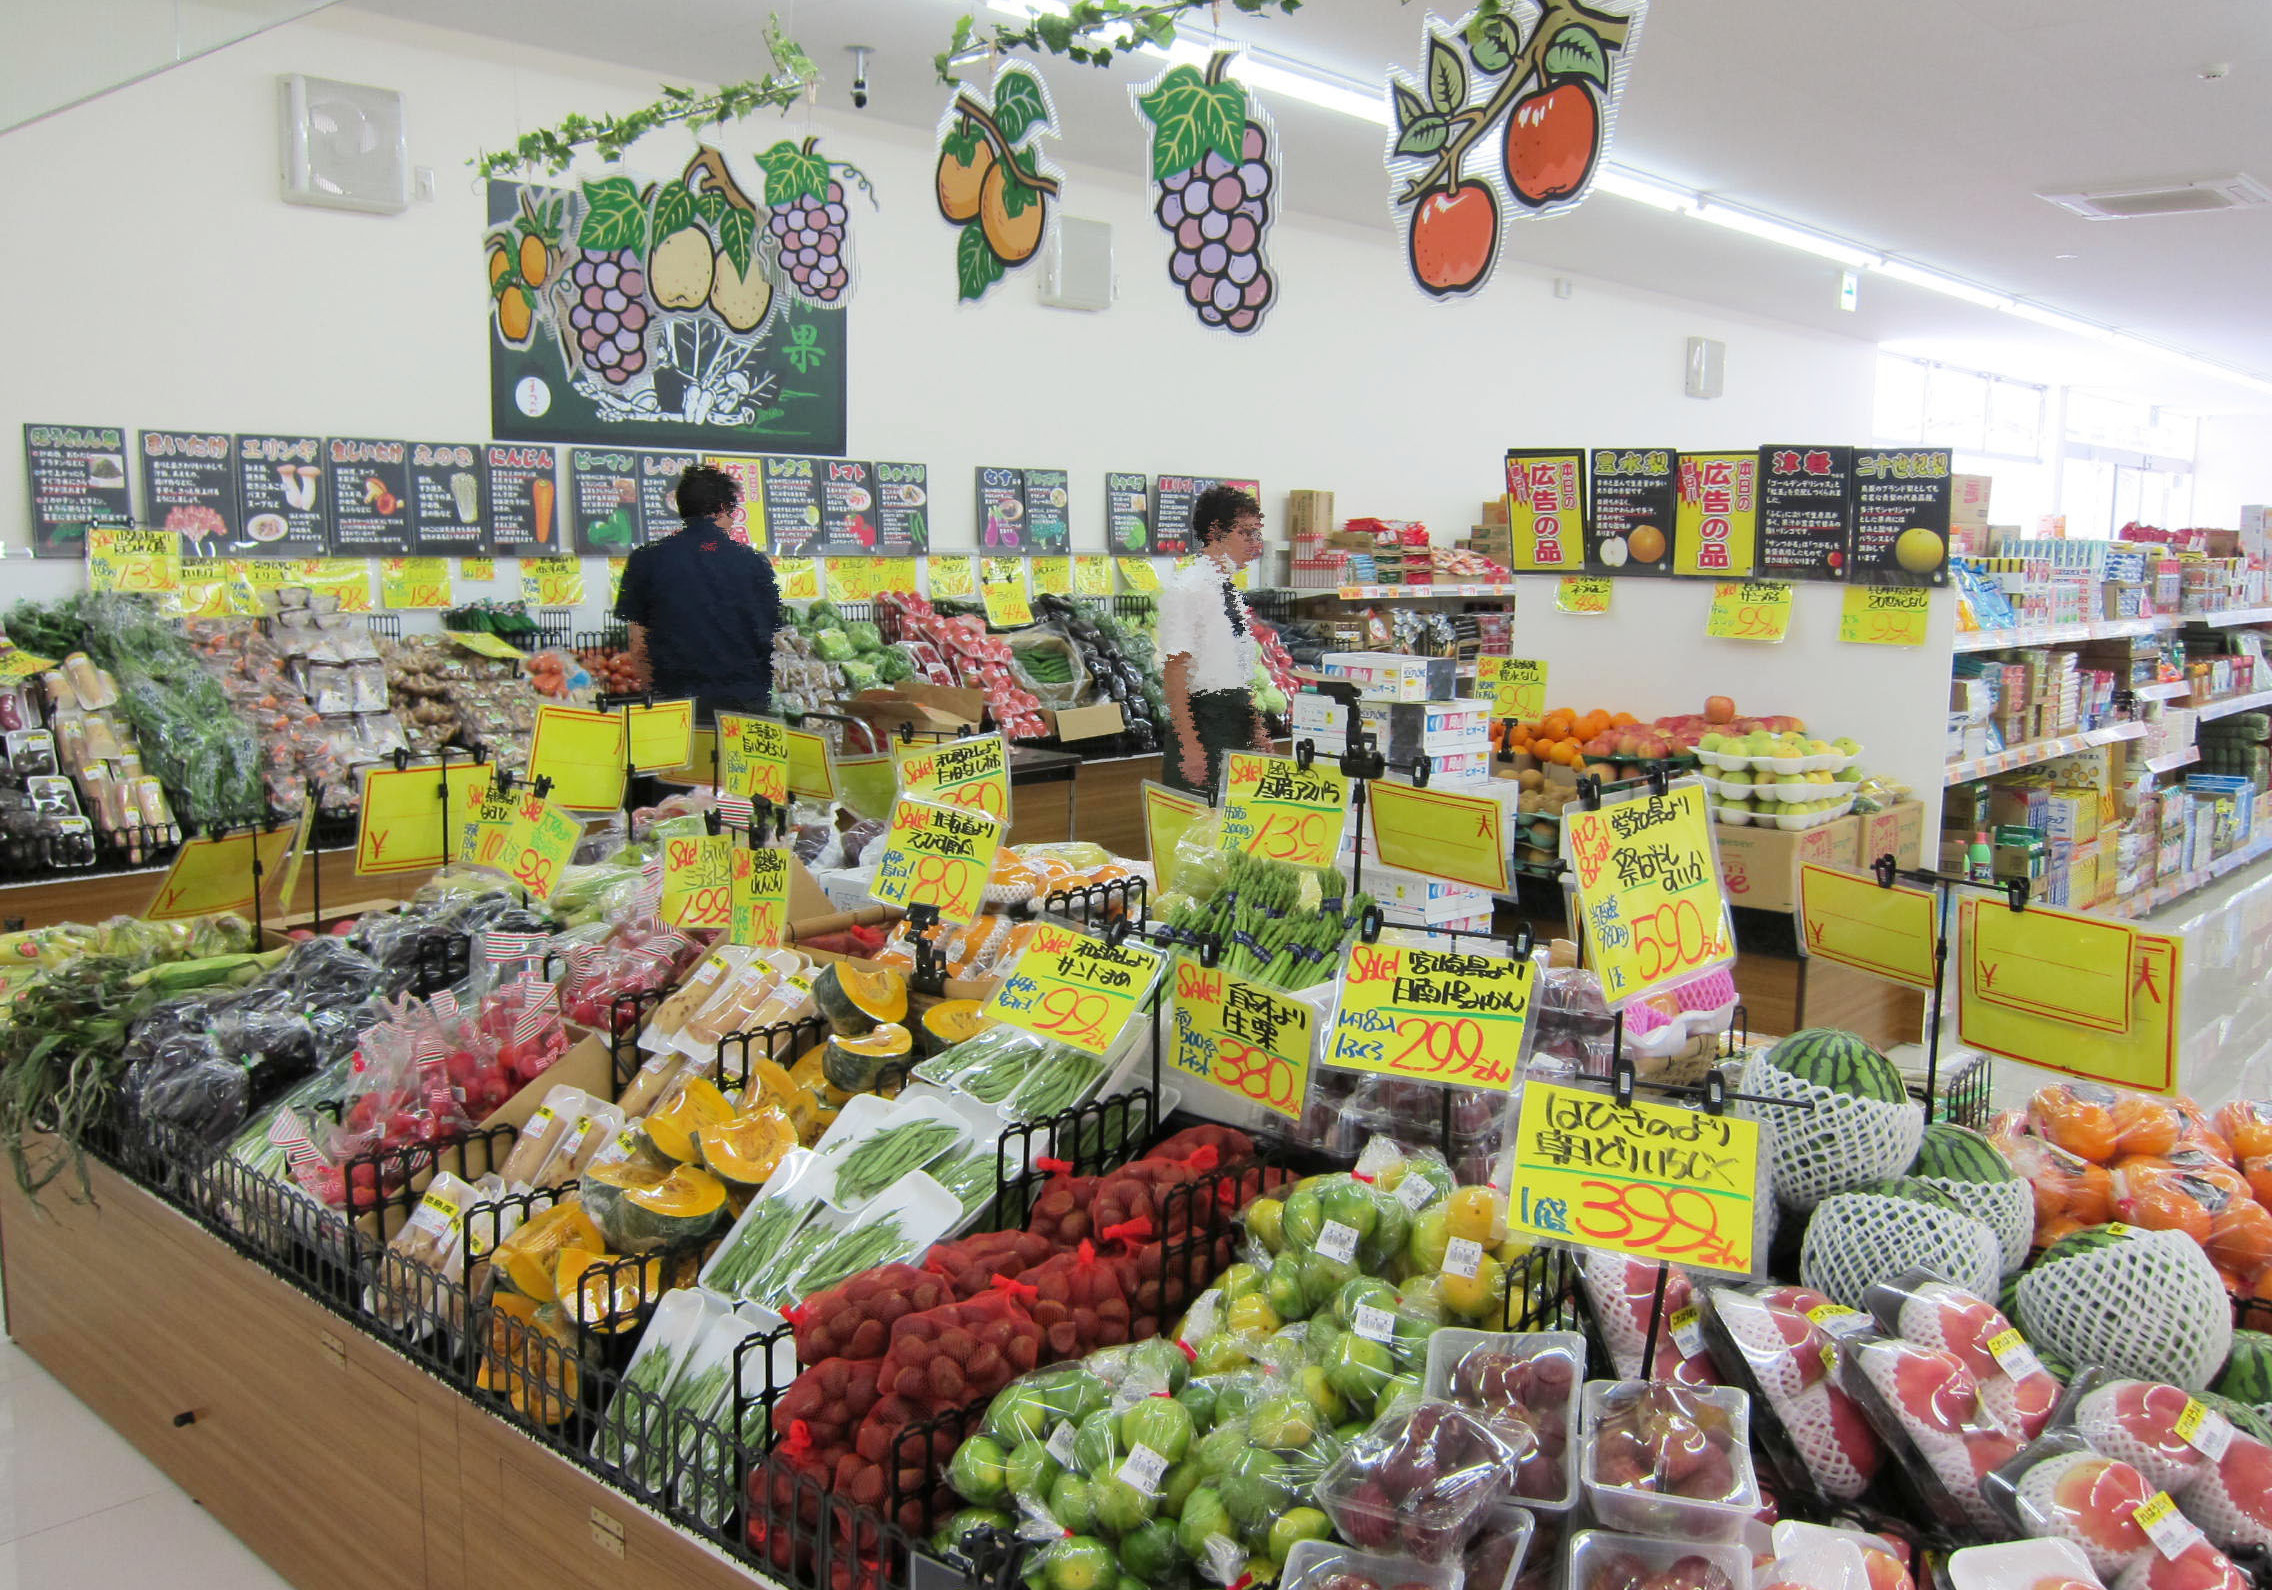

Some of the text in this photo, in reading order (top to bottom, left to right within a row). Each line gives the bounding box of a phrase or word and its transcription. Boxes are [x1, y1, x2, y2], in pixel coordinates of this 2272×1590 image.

[782, 324, 826, 374] 果
[241, 438, 318, 462] エリンギ
[413, 444, 473, 467] えのき
[488, 446, 554, 468] にんじん
[574, 451, 634, 472] ピーマン
[1593, 450, 1671, 476] 豊水梨
[767, 458, 813, 478] レタス
[829, 461, 866, 482] トマト
[877, 464, 926, 483] きゅうり
[1855, 453, 1949, 479] 二十世紀梨
[1561, 461, 1578, 510] 本日の
[1736, 460, 1755, 512] 本日の
[1529, 462, 1565, 565] 広告の品
[1697, 461, 1735, 571] 広告の品
[1546, 1092, 1731, 1148] はびきのより
